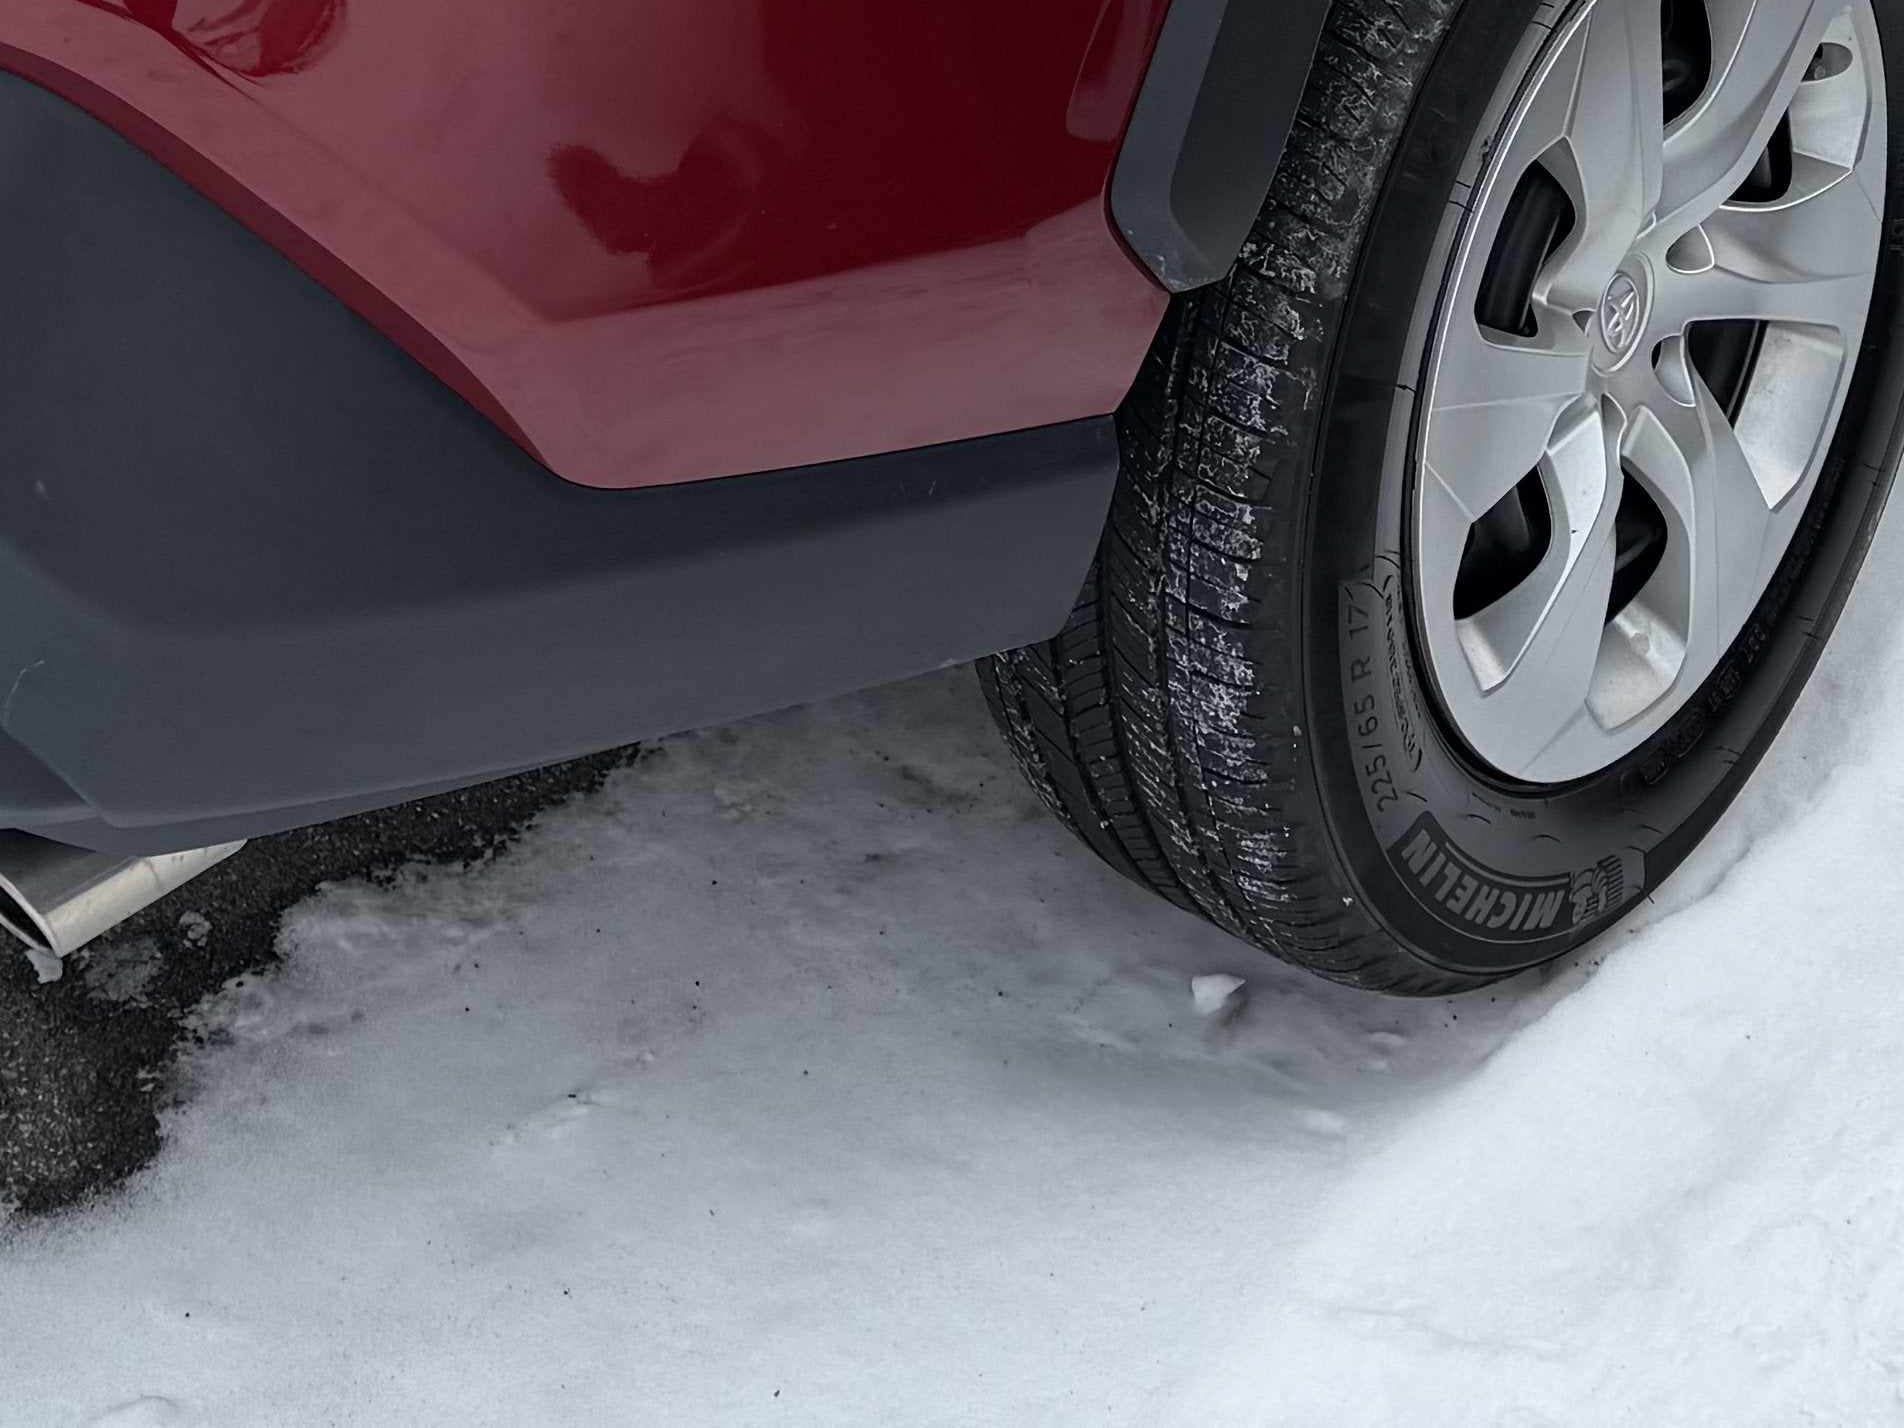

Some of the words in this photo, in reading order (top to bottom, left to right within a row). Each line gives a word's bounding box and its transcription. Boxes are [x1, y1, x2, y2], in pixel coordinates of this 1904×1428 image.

[1347, 603, 1371, 642] 17
[1350, 655, 1373, 682] R
[1353, 693, 1399, 813] 225/65
[1401, 828, 1567, 932] MICHELIN
